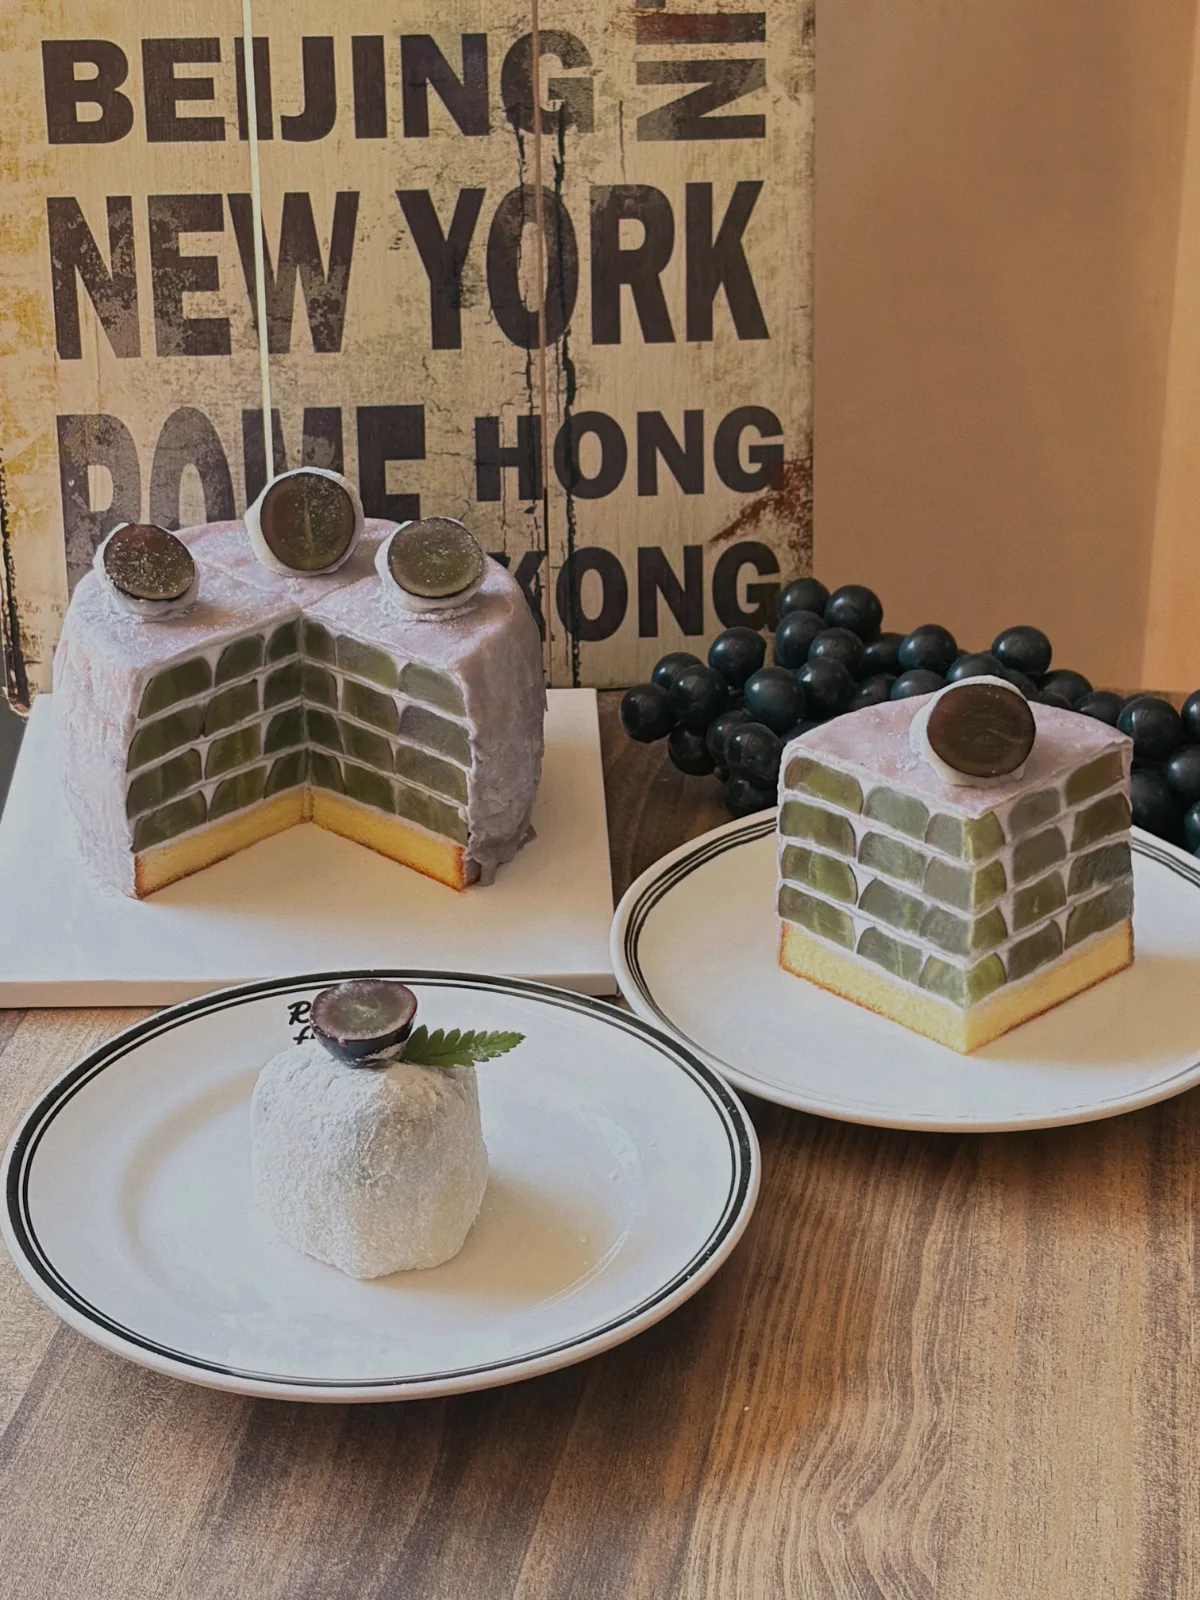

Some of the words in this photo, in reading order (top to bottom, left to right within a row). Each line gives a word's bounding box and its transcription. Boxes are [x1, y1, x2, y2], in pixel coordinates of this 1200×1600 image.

[41, 29, 595, 145] BEIJING
[46, 191, 360, 360] NEW
[394, 180, 770, 351] YORK
[474, 405, 785, 503] HONG
